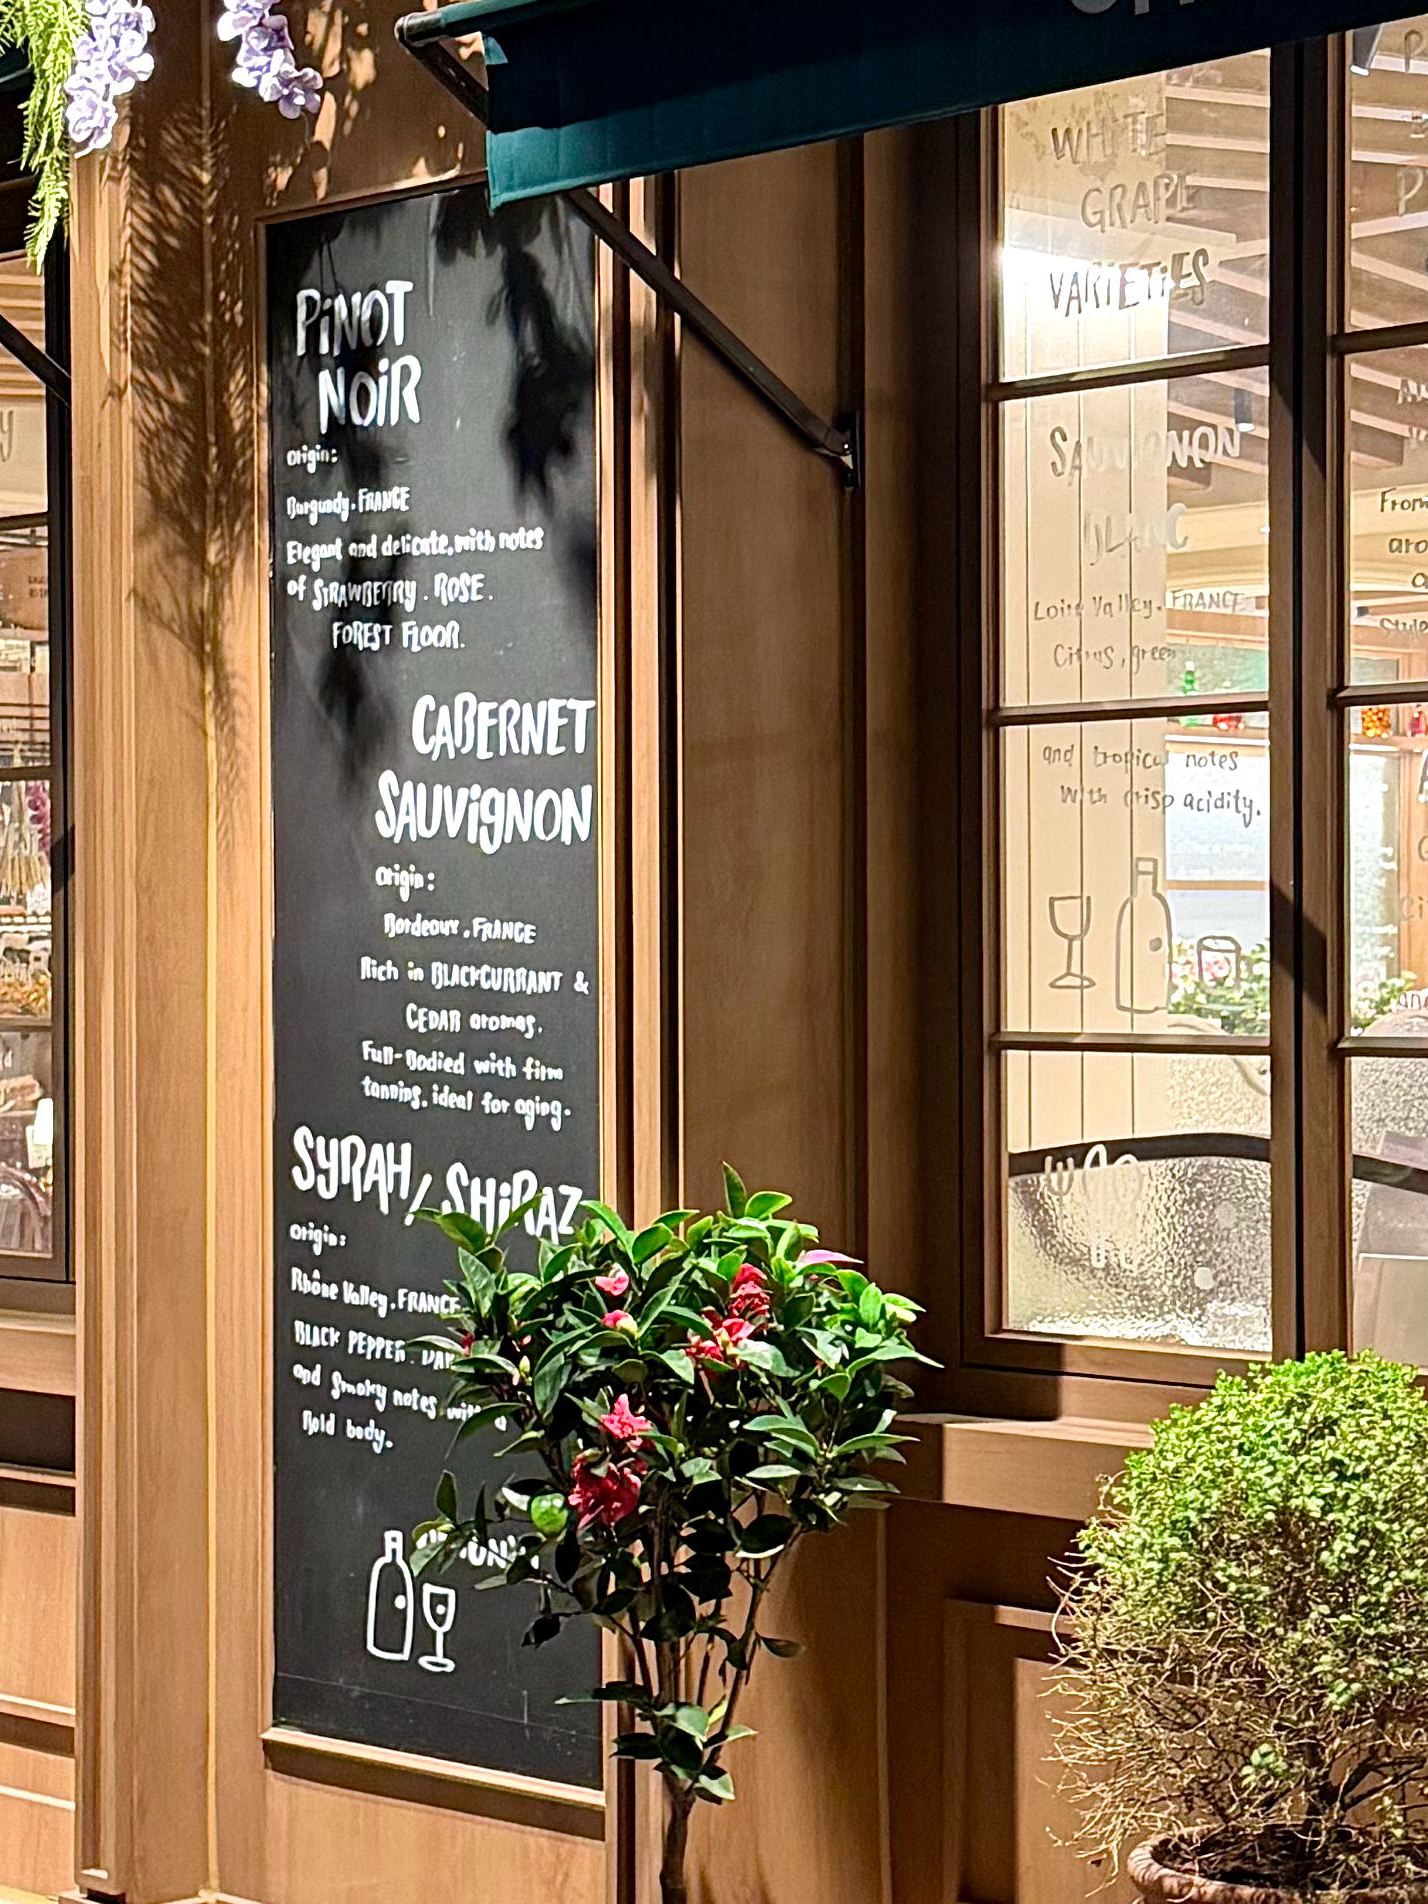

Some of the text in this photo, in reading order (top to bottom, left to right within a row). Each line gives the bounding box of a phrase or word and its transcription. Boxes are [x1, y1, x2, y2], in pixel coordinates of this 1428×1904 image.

[1080, 171, 1199, 234] GRAPE
[358, 486, 411, 514] FRANCE
[286, 537, 343, 573] Elegant
[348, 534, 378, 559] and
[454, 527, 496, 553] with
[498, 526, 545, 551] notes
[286, 575, 307, 602] of
[332, 621, 393, 652] FOREST
[411, 690, 597, 762] CABERNET
[1042, 744, 1075, 768] and
[1185, 750, 1239, 772] notes
[1123, 786, 1175, 814] crisp
[472, 916, 538, 945] FRANCE
[359, 955, 590, 996] Rich in BLACKCURRANT &
[405, 1002, 462, 1034] CEDAR
[473, 1052, 518, 1079] with
[522, 1056, 565, 1082] firm
[431, 1083, 474, 1112] ideal
[480, 1090, 511, 1115] for
[290, 1266, 339, 1300] Rhône
[293, 1319, 341, 1347] BLACK
[292, 1362, 323, 1387] and
[392, 1387, 438, 1420] notes
[302, 1409, 336, 1436] Bold
